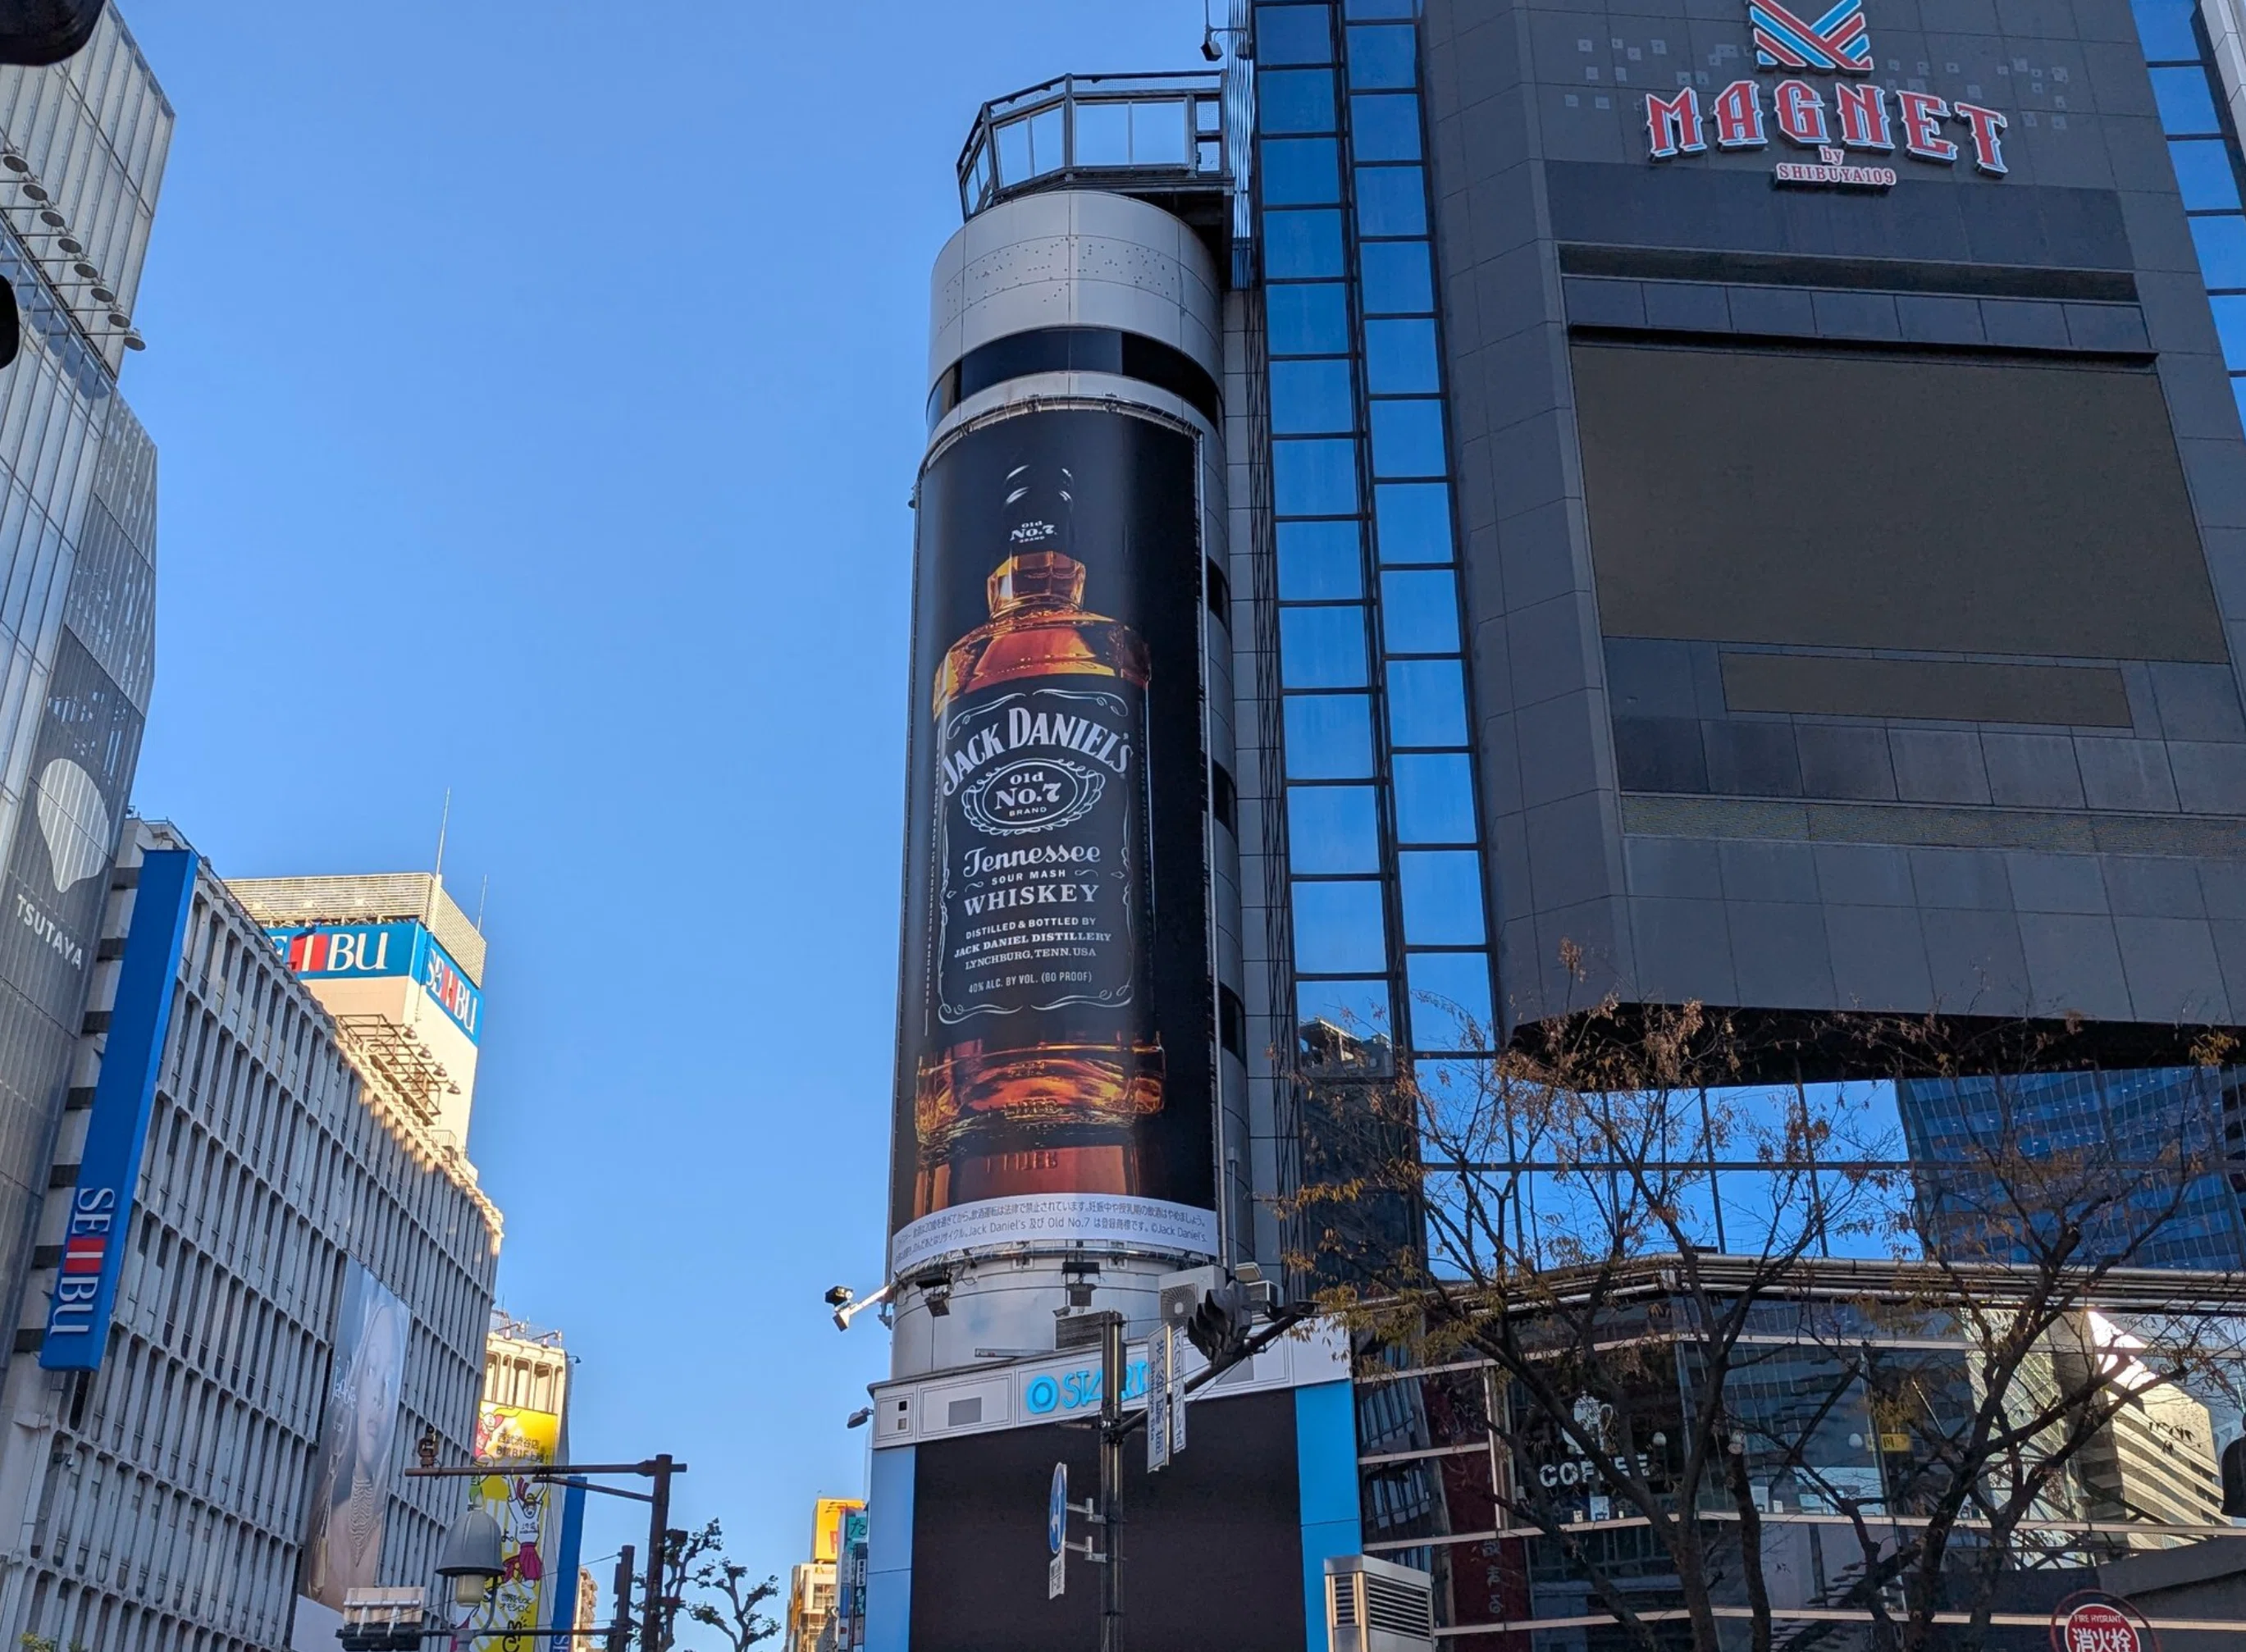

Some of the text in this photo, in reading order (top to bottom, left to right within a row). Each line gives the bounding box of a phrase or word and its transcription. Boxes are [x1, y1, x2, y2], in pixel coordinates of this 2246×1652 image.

[1646, 80, 2007, 177] MAGNET
[1819, 147, 1843, 165] by
[1776, 163, 1896, 186] SHIBUYA109
[943, 707, 1134, 796] JACK DANIEL'S
[1010, 772, 1043, 785] Old
[1008, 806, 1047, 817] BRAND
[963, 844, 1101, 878] Tennessee
[991, 869, 1066, 886] SOUR MASH
[964, 884, 1099, 916] WHISKEY
[17, 894, 82, 970] TSUTAYA
[966, 917, 1097, 939] DISTILLED & BOTTLED BY
[954, 932, 1112, 958] JACK DANIEL DISTILLERY
[965, 947, 1096, 970] LYNCHBURG, TENN. USA
[427, 948, 477, 1035] SEIBU
[968, 982, 984, 993] 40%
[986, 979, 1003, 990] ALC.
[1006, 975, 1016, 987] BY
[1019, 974, 1038, 984] VOL.
[1060, 971, 1093, 983] PROOF)
[990, 1221, 1025, 1233] Daniel's
[1048, 1217, 1064, 1229] Old
[1067, 1217, 1089, 1228] No.7
[49, 1188, 115, 1337] SEIBU
[2075, 1614, 2122, 1623] FIRE HYDRANT
[2071, 1627, 2132, 1652] 消火栓
